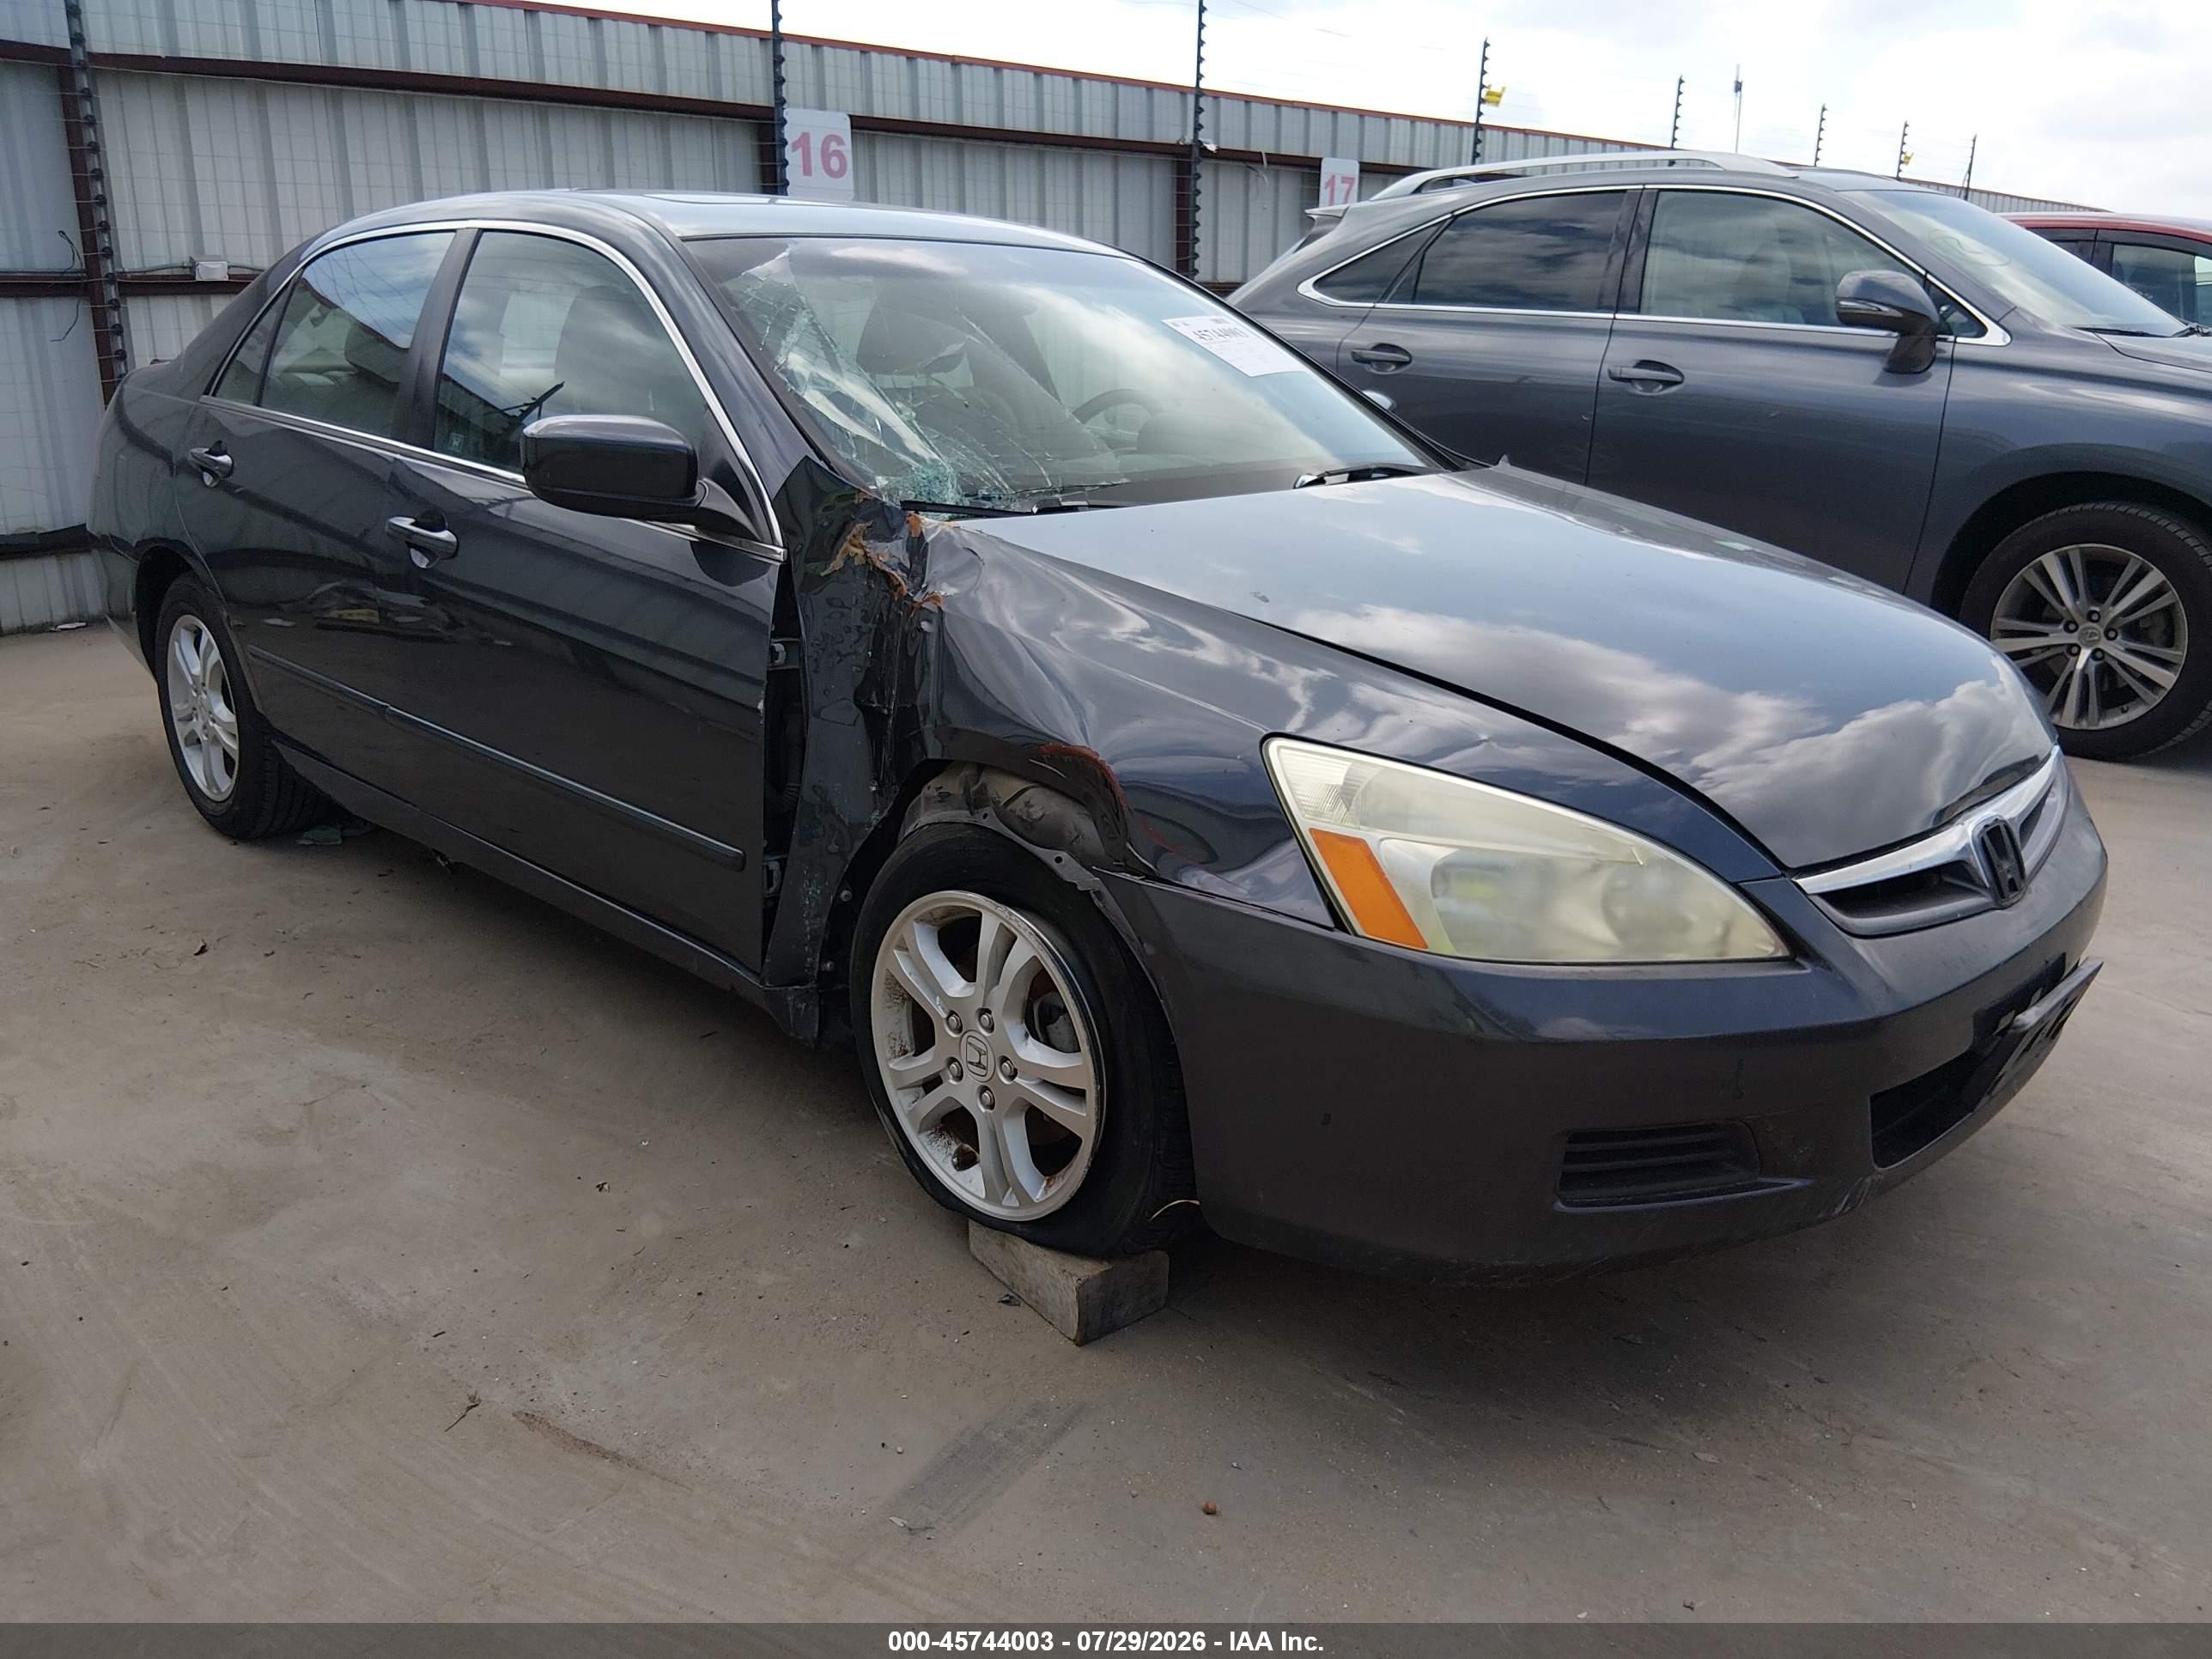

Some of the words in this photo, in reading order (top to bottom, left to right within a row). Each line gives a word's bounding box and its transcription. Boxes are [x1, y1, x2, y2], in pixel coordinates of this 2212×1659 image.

[791, 131, 848, 179] 16
[1324, 174, 1356, 207] 17
[1191, 326, 1250, 341] 45744
